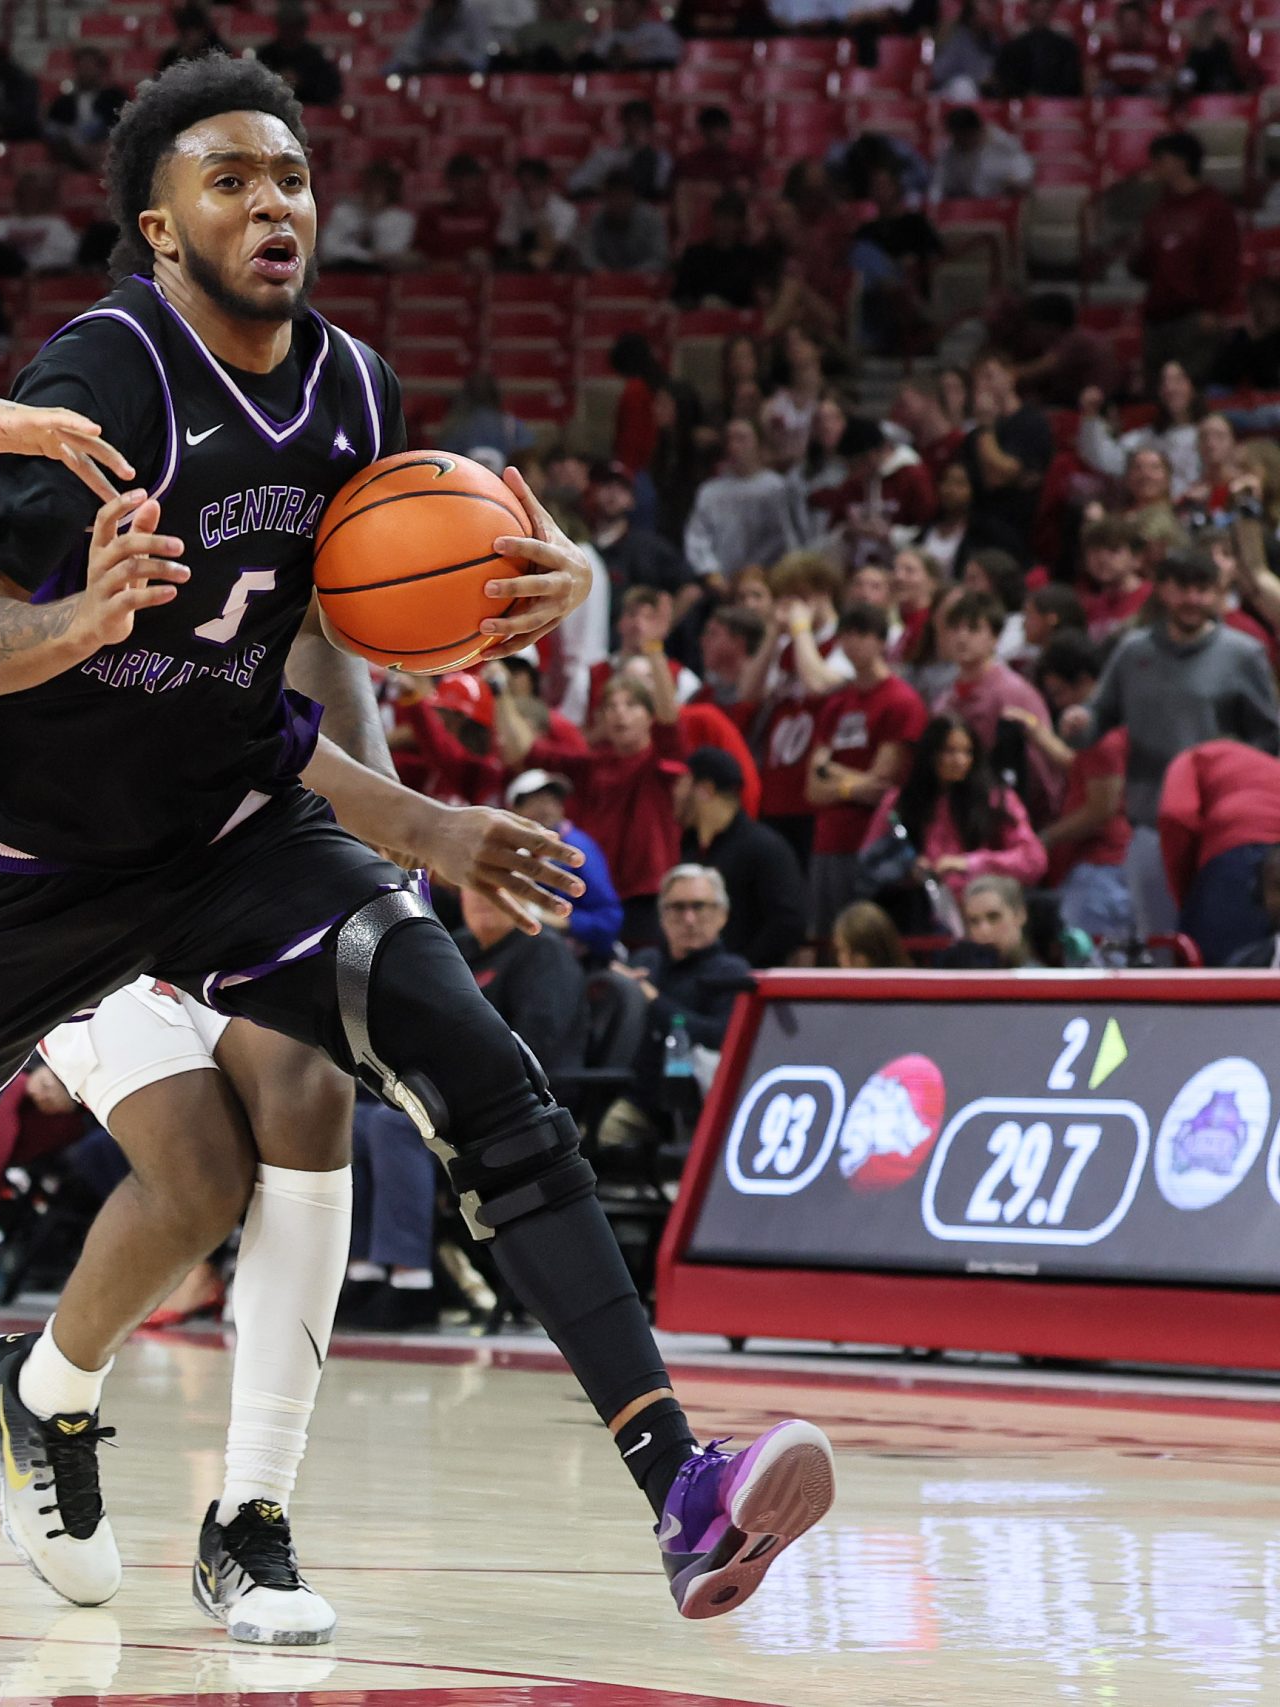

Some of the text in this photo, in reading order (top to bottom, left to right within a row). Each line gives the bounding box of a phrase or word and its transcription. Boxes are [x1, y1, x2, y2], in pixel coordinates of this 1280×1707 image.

[200, 485, 325, 549] CENTRA
[1047, 1016, 1090, 1091] 2
[752, 1092, 817, 1175] 93
[965, 1119, 1103, 1226] 29.7
